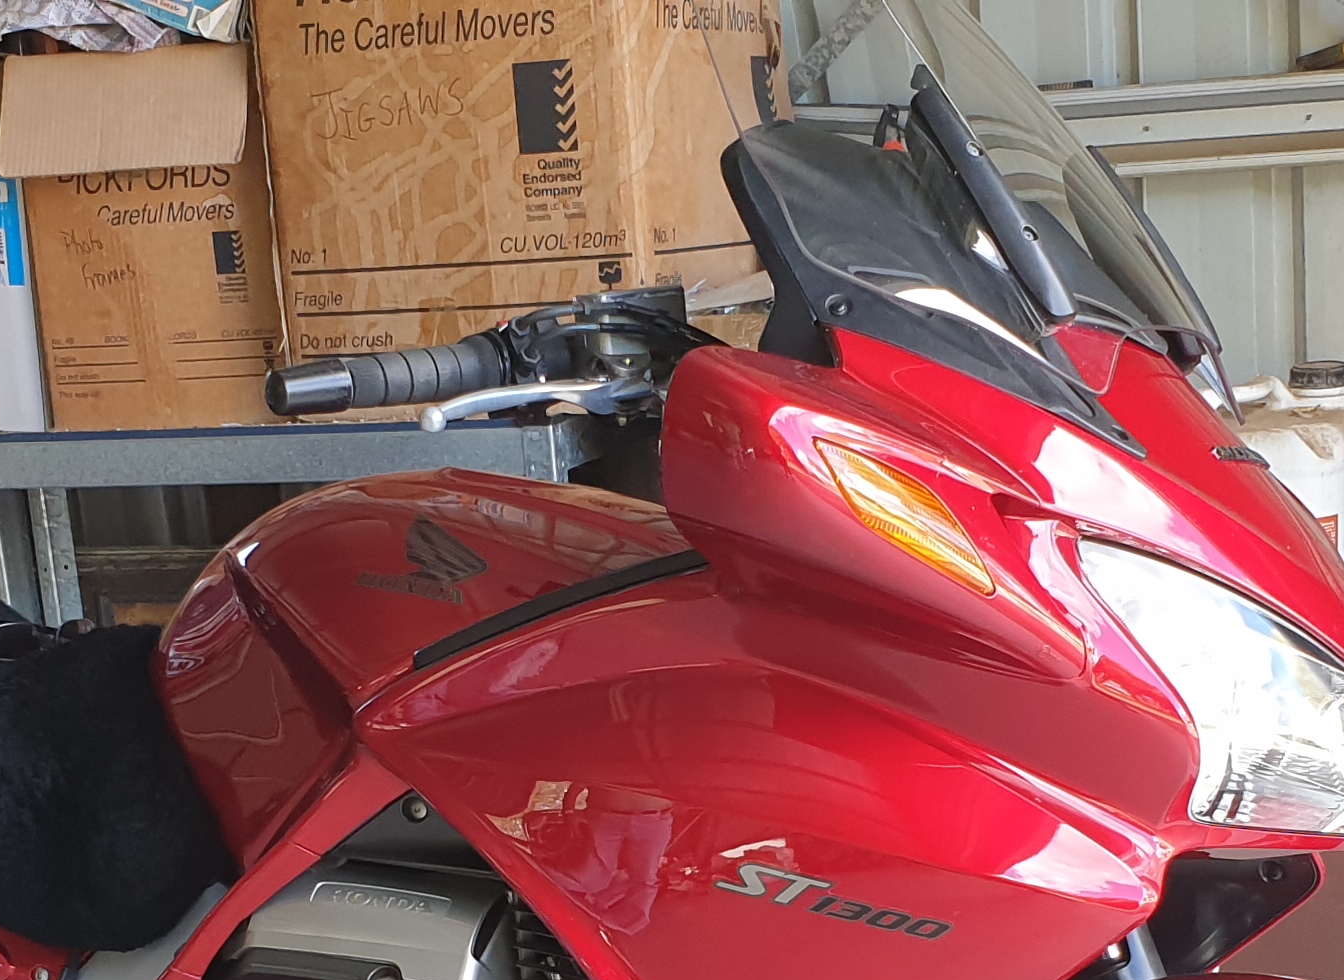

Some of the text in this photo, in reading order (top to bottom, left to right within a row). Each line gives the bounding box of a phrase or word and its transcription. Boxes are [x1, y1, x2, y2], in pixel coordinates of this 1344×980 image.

[299, 8, 555, 56] The Careful Movers
[310, 77, 464, 141] JIGSAWS
[537, 157, 581, 171] Quality
[522, 171, 582, 185] Endorsed
[524, 186, 583, 199] Company
[97, 200, 235, 226] Careful Movers
[290, 247, 327, 264] No. 1
[294, 290, 343, 310] Fragile
[300, 331, 393, 350] Do not crush
